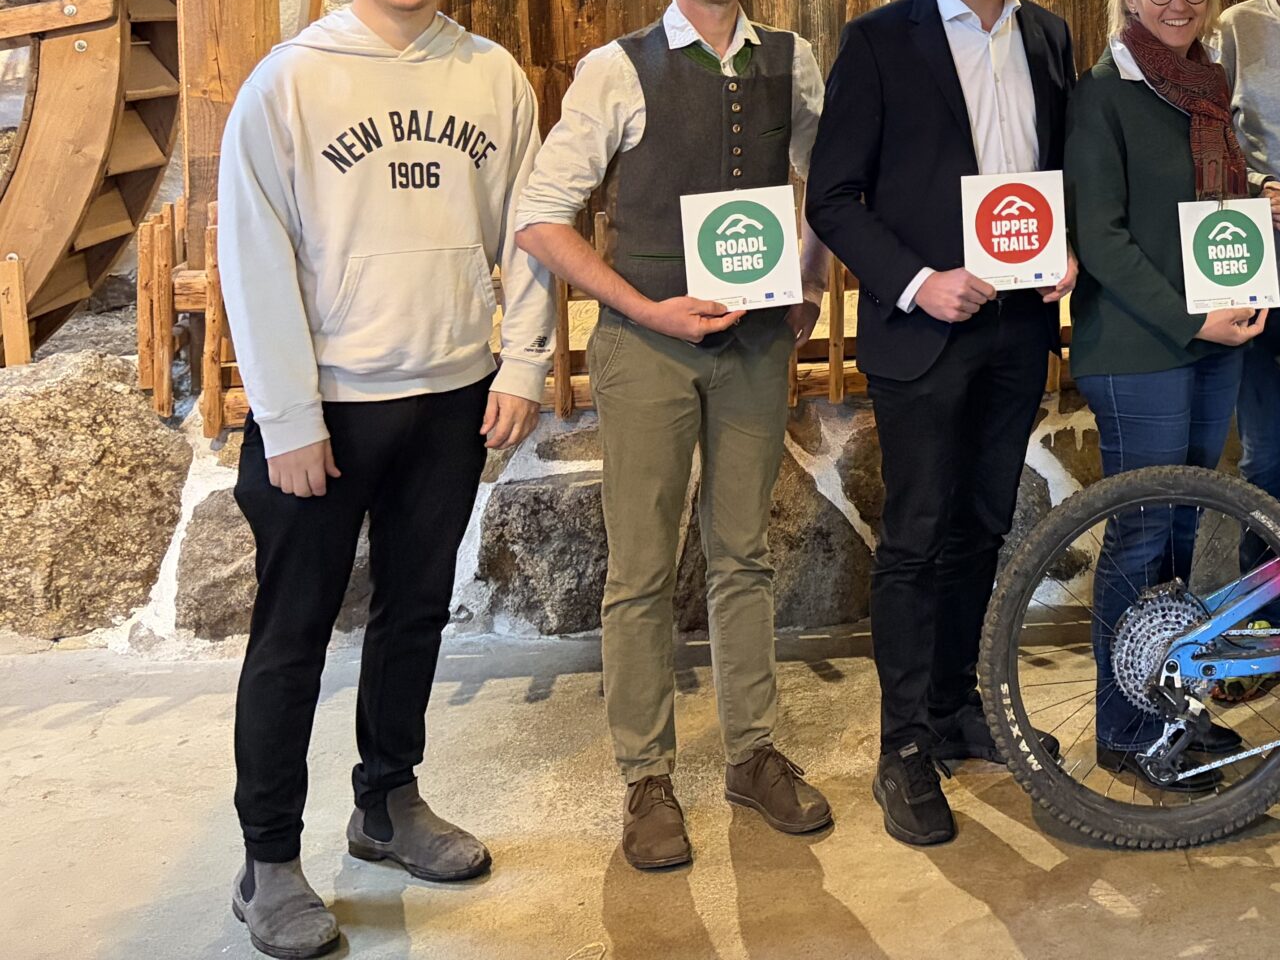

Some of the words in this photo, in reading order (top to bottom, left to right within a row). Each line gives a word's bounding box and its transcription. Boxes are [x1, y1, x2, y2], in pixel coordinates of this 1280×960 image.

[321, 117, 384, 175] NEW
[388, 109, 497, 170] BALANCE
[388, 161, 441, 189] 1906
[991, 218, 1038, 236] UPPER
[715, 236, 768, 257] ROADL
[991, 235, 1040, 253] TRAILS
[1207, 243, 1250, 259] ROADL
[721, 253, 764, 273] BERG
[1213, 260, 1248, 275] BERG
[1000, 683, 1043, 772] MAXXIS
